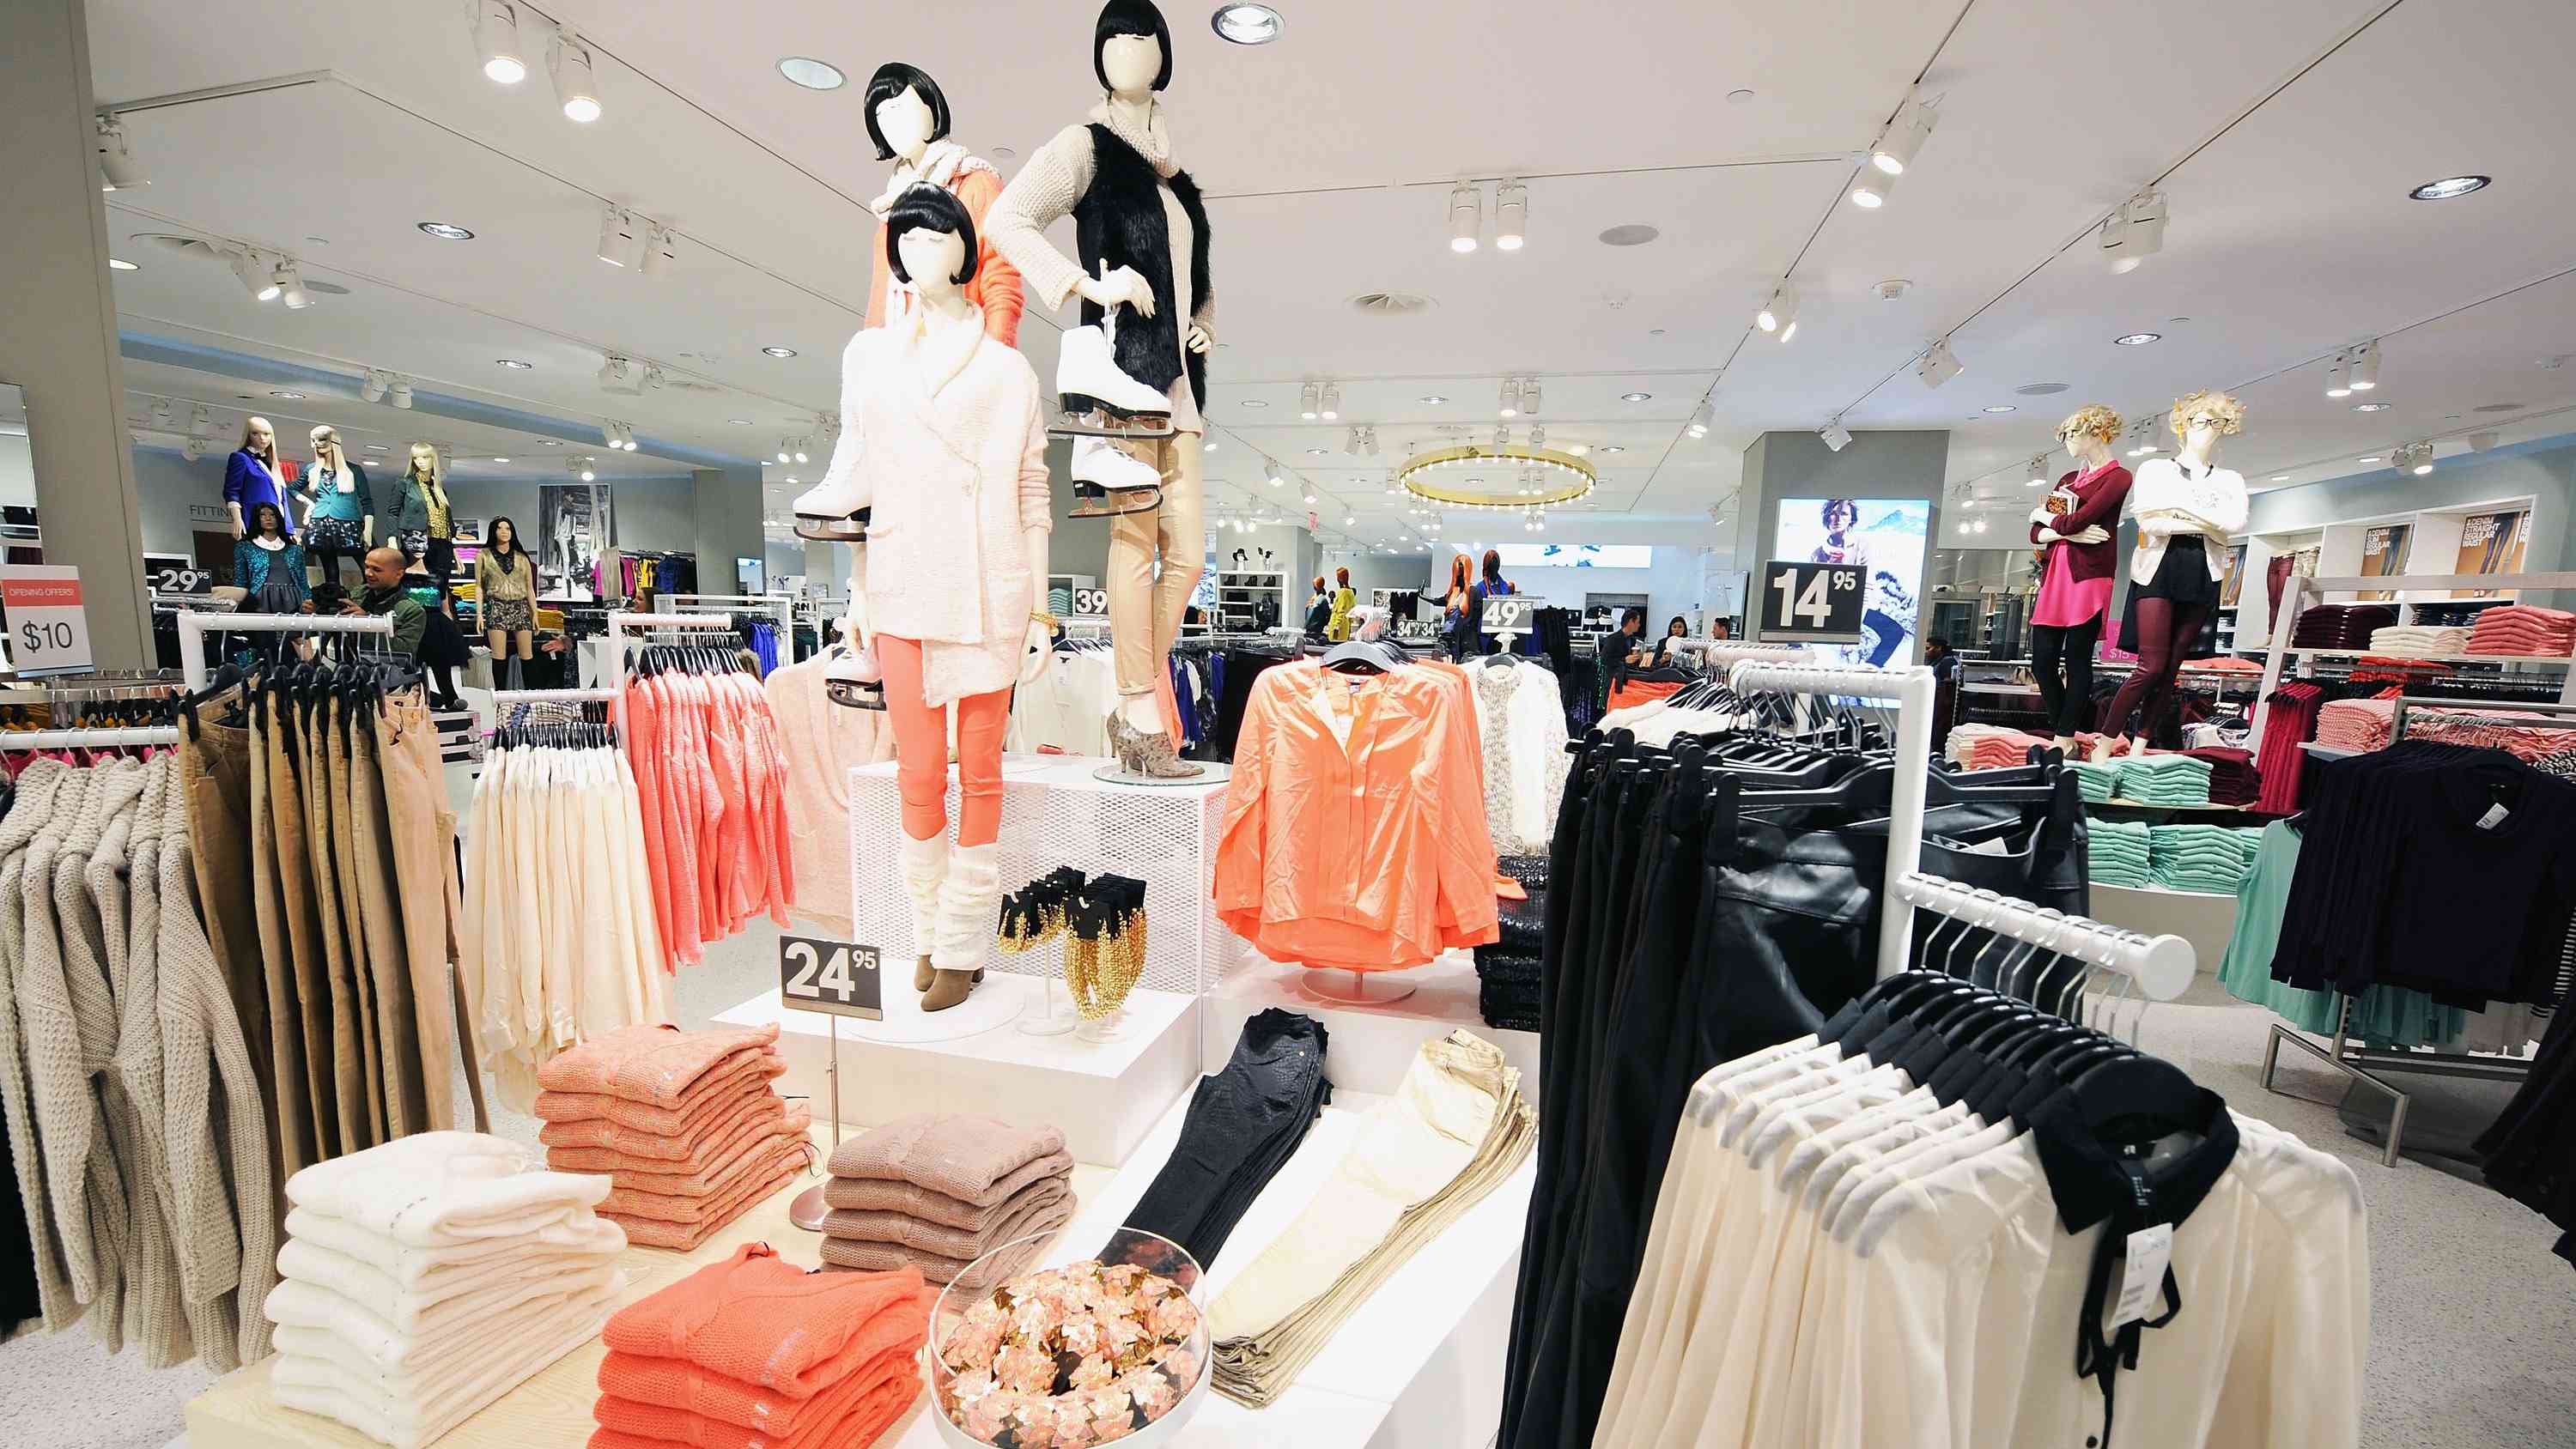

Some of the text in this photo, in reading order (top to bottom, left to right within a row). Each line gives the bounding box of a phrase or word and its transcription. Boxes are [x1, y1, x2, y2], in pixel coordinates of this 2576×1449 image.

[190, 505, 234, 517] FITTIN
[9, 587, 44, 597] OPENING
[1076, 590, 1108, 614] 39
[22, 620, 72, 653] $10
